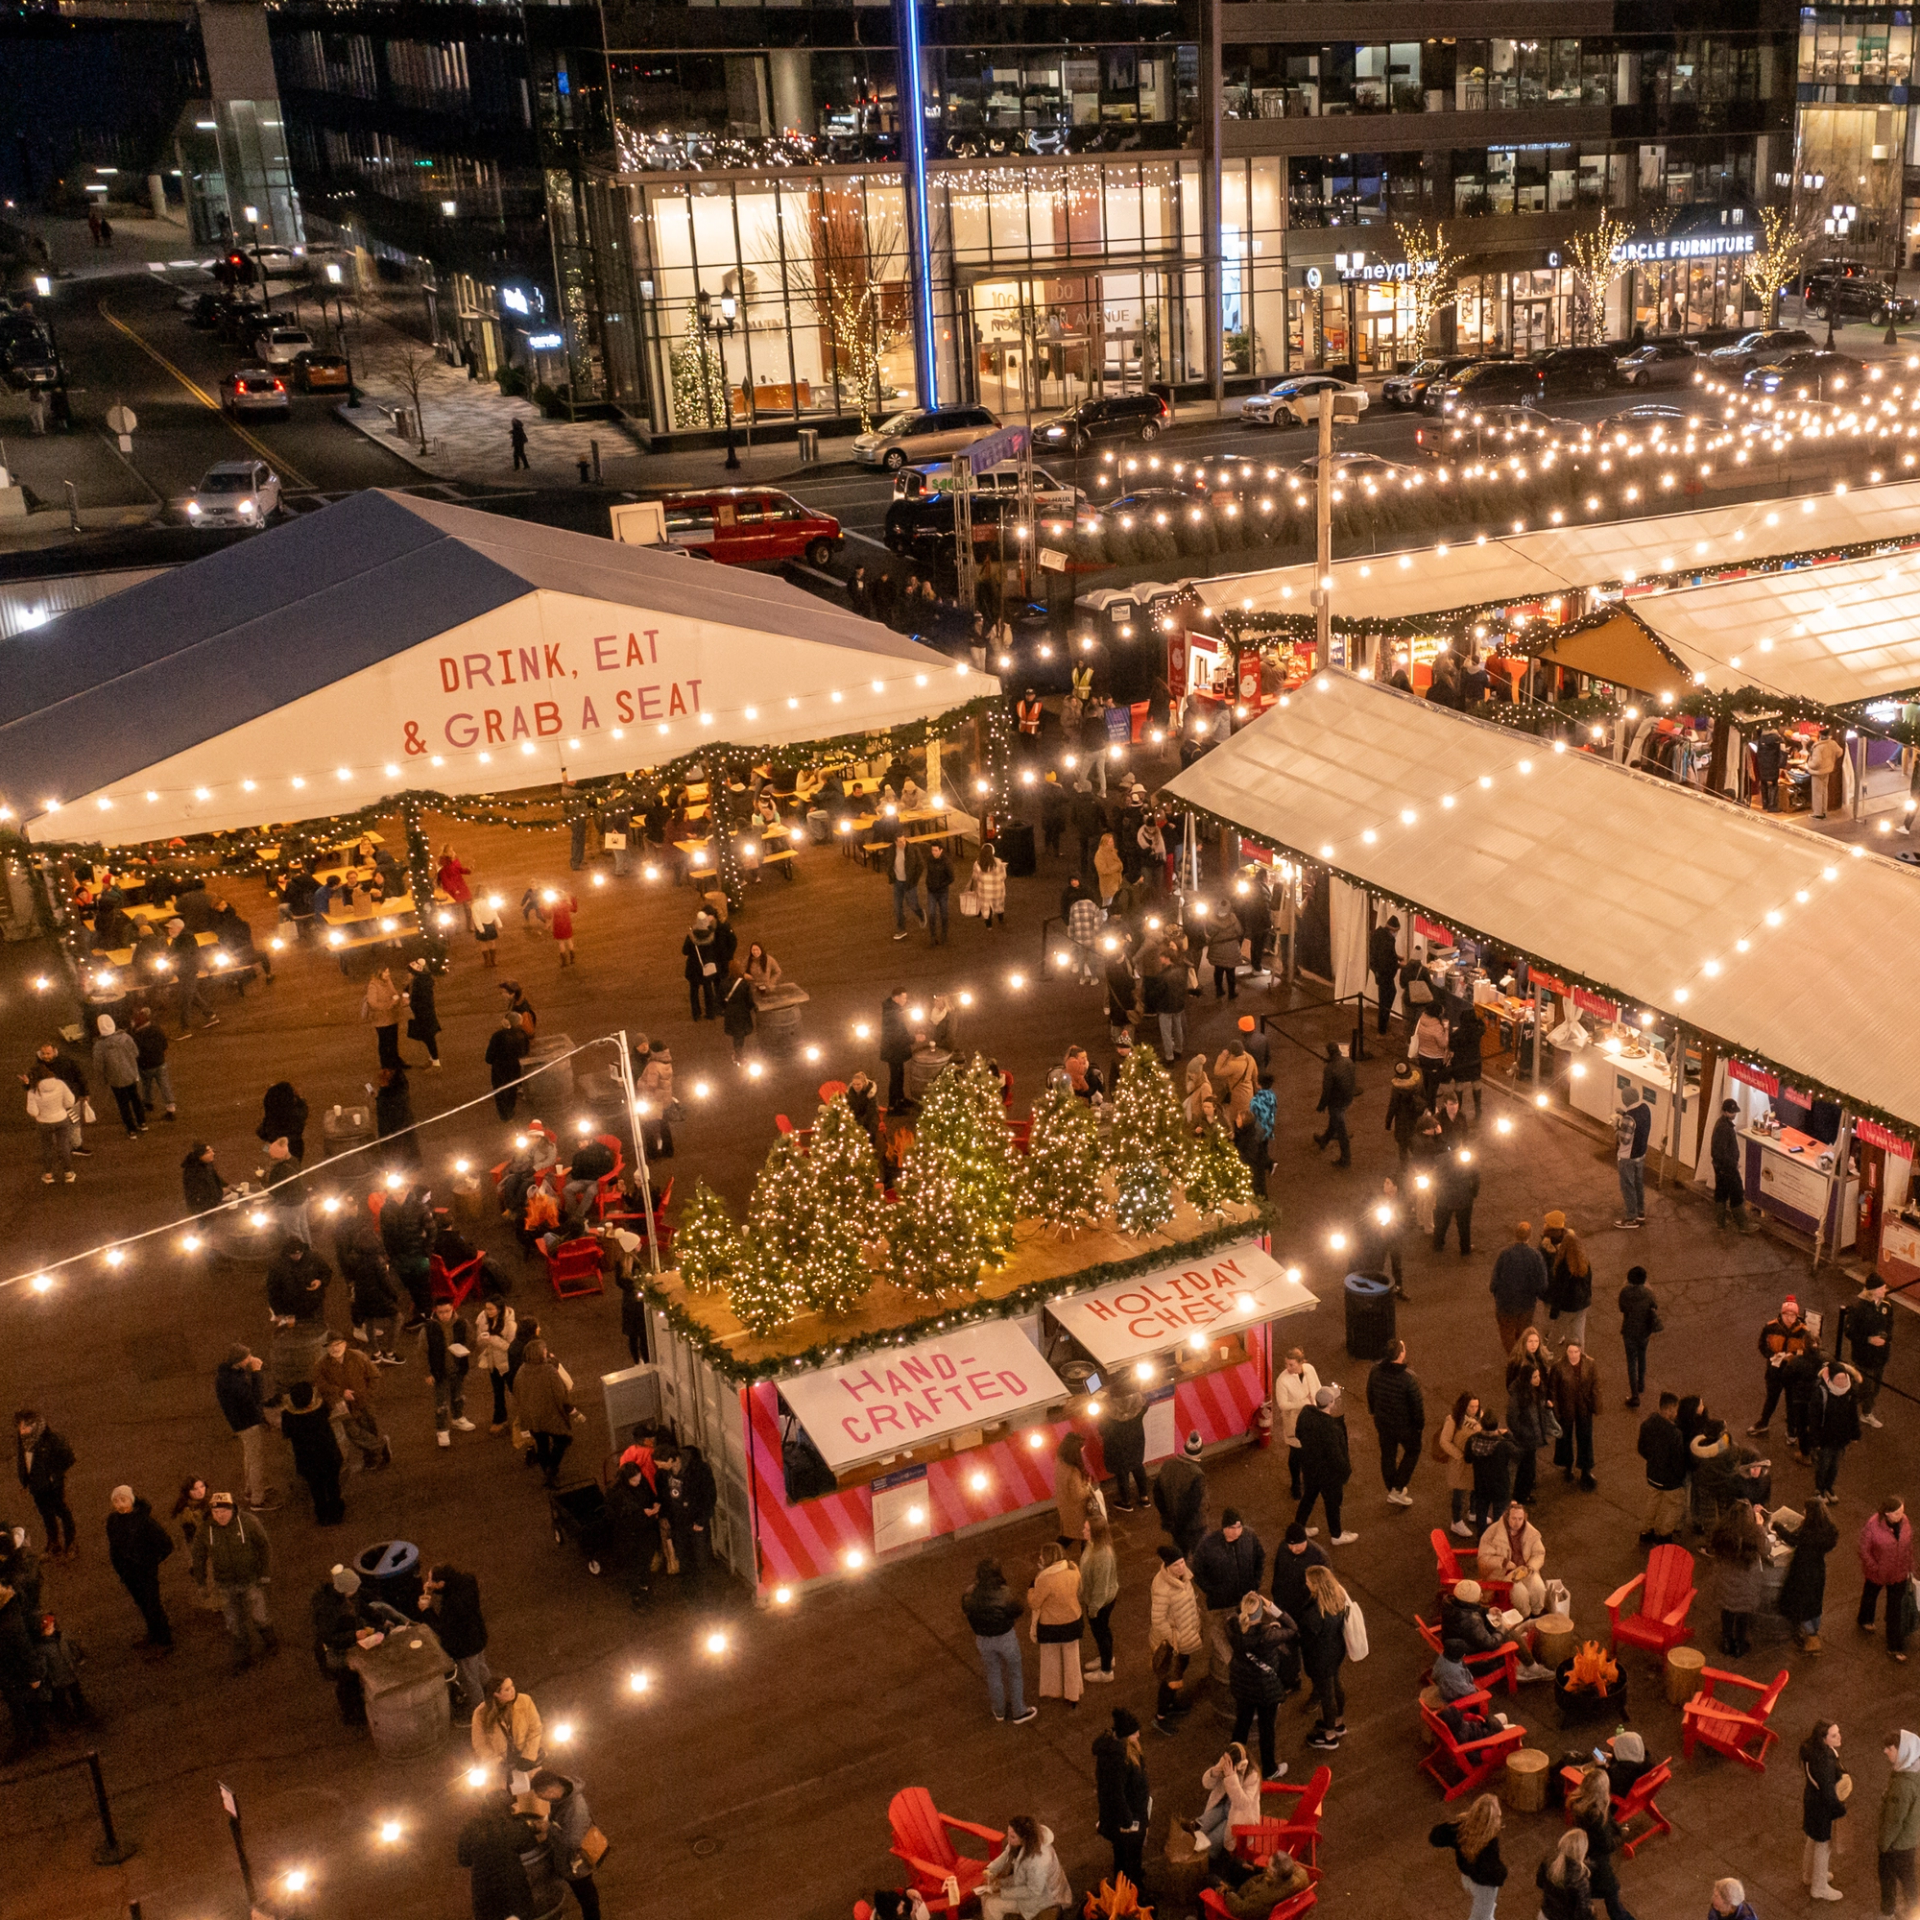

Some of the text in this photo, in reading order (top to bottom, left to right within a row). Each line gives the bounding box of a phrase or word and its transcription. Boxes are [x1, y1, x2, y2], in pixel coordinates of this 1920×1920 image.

[1612, 235, 1755, 262] CIRCLE FURNITURE
[1075, 309, 1130, 327] AVENUE
[439, 629, 660, 693] DRINK, EAT
[403, 679, 703, 756] & GRAB A SEAT
[1084, 1258, 1247, 1322] HOLIDAY
[1128, 1288, 1267, 1339] CHEER
[838, 1353, 977, 1403] HAND-
[841, 1369, 1029, 1444] CRAFTED
